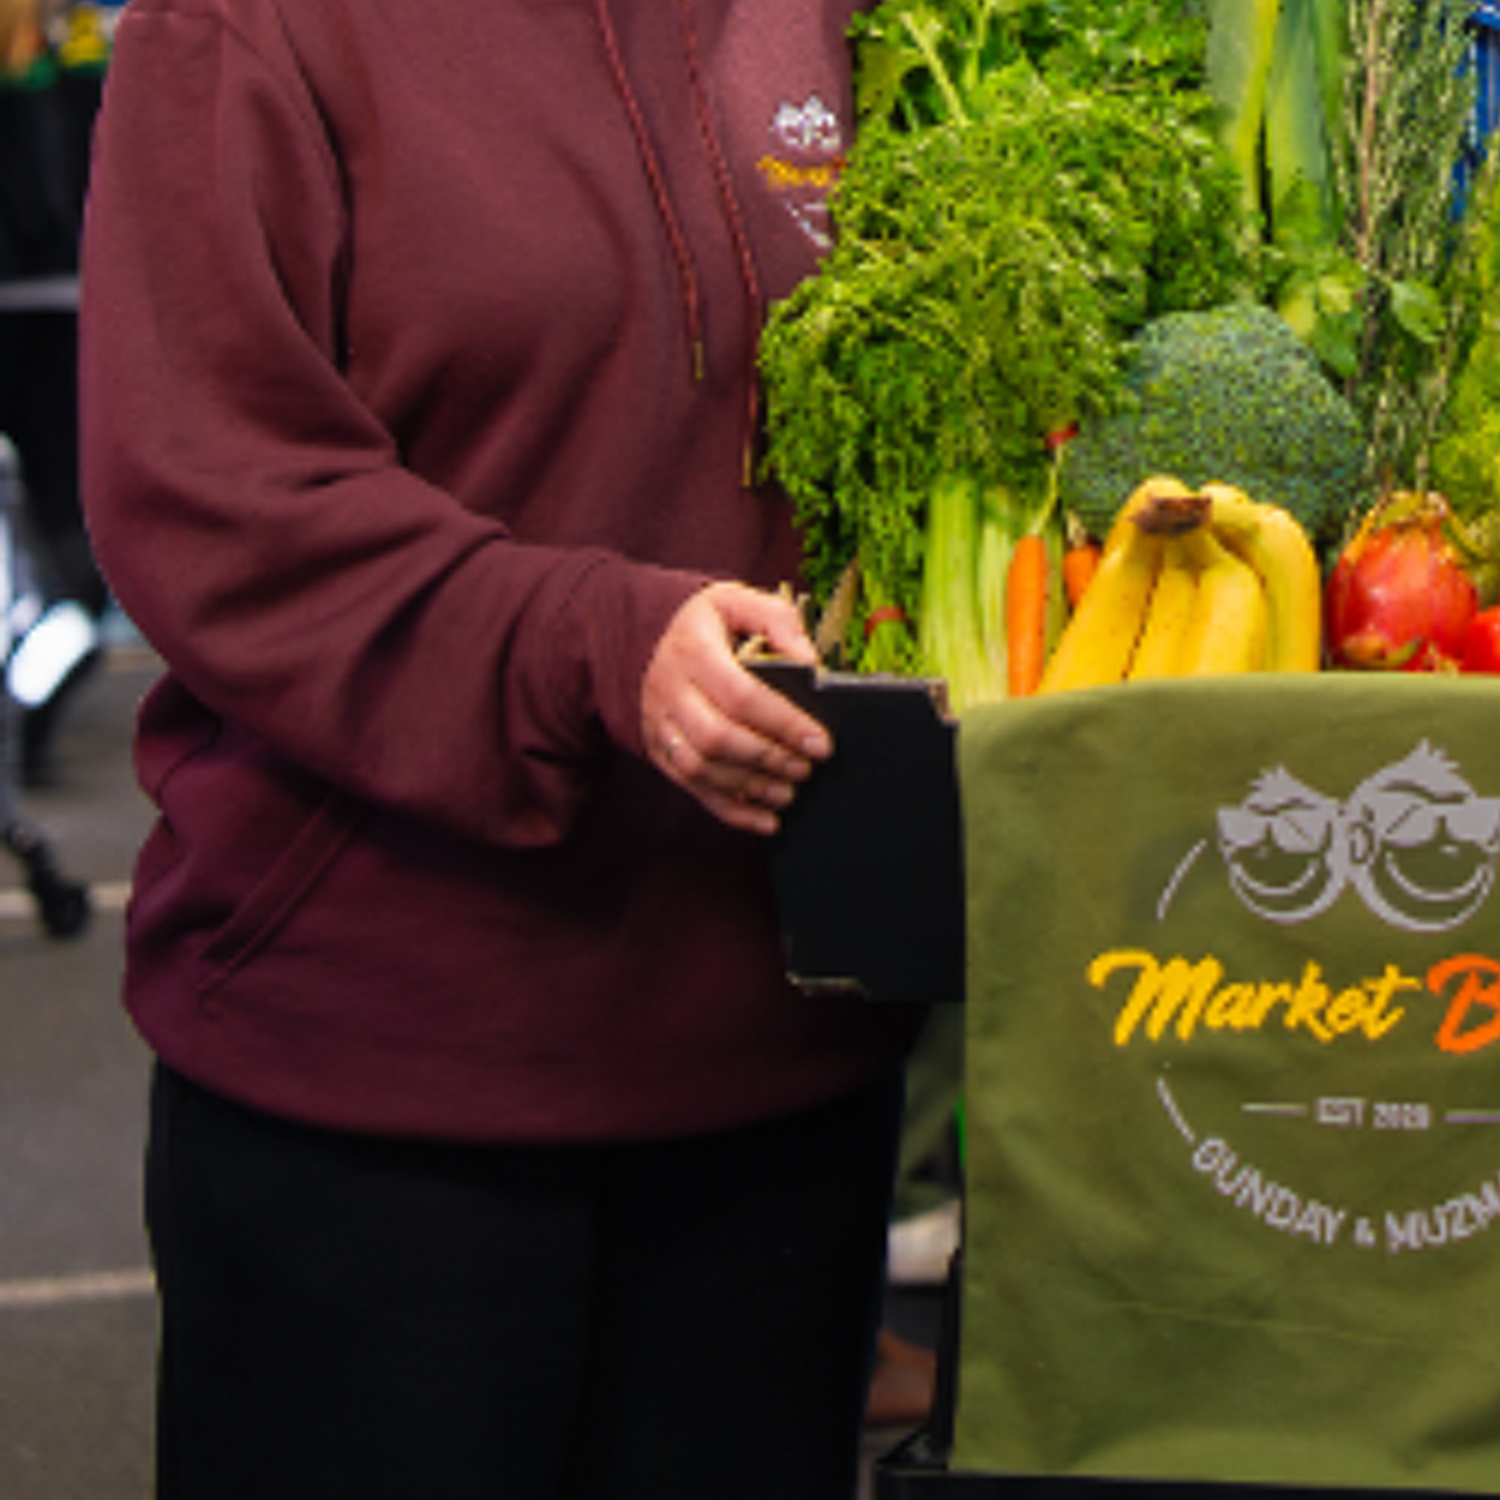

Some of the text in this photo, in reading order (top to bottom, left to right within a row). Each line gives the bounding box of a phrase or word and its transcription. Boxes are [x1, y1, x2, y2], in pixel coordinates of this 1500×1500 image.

[1089, 950, 1422, 1046] Market
[1317, 1096, 1366, 1128] EST
[1191, 1137, 1347, 1245] GUNDAY
[1354, 1216, 1377, 1248] &
